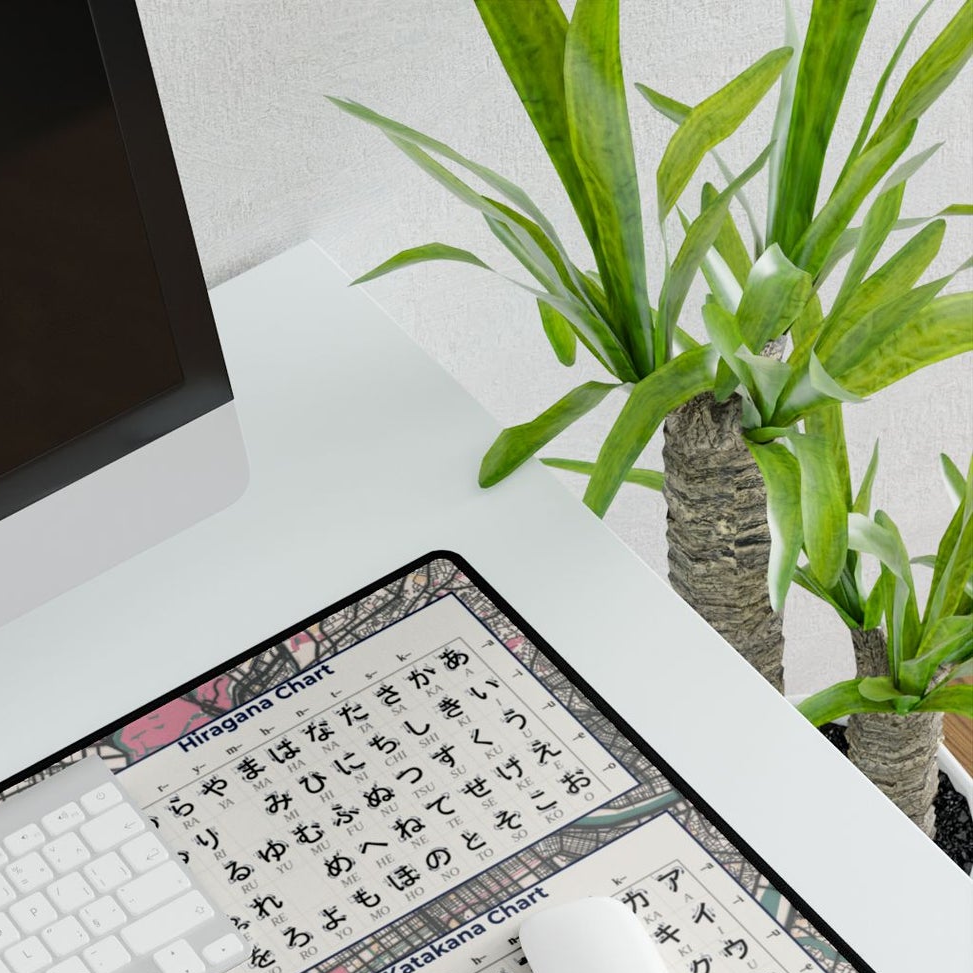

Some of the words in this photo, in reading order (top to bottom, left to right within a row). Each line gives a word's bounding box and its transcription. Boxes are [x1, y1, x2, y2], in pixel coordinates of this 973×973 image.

[438, 649, 469, 670] あ
[408, 668, 436, 689] か
[376, 685, 401, 707] さ
[425, 684, 444, 698] KA
[470, 681, 499, 700] い
[177, 698, 274, 753] Hiragana
[275, 664, 335, 700] Chart
[339, 704, 369, 726] た
[391, 704, 408, 716] SA
[439, 698, 463, 718] き
[357, 722, 374, 734] TA
[404, 721, 430, 736] し
[457, 714, 472, 727] KI
[504, 709, 526, 730] う
[305, 722, 335, 742] な
[418, 732, 440, 749] SHI
[473, 729, 493, 745] く
[268, 740, 301, 764] は
[321, 740, 341, 754] NA
[369, 735, 397, 754] ち
[484, 744, 503, 760] KU
[532, 741, 562, 764] え
[286, 759, 306, 773] HA
[334, 752, 366, 775] に
[384, 750, 408, 767] CHI
[432, 745, 455, 768] す
[237, 758, 266, 780] ま
[354, 771, 369, 784] NI
[396, 767, 423, 784] つ
[450, 764, 467, 779] SU
[496, 758, 523, 780] け
[202, 779, 228, 797] や
[299, 773, 327, 794] ひ
[411, 782, 436, 799] TSU
[464, 778, 492, 798] せ
[515, 776, 534, 791] KE
[561, 771, 591, 794] お
[264, 793, 293, 814] み
[319, 790, 335, 803] HI
[363, 787, 395, 808] ぬ
[426, 796, 455, 815] て
[481, 797, 498, 810] SE
[531, 791, 557, 811] こ
[170, 796, 194, 817] ら
[380, 802, 399, 818] NU
[544, 806, 564, 824] KO
[332, 806, 359, 827] ふ
[446, 815, 464, 829] TE
[496, 811, 522, 830] そ
[293, 823, 323, 844] む
[346, 821, 364, 837] FU
[394, 818, 426, 839] ね
[511, 825, 528, 843] SO
[196, 828, 219, 850] り
[410, 834, 429, 849] NE
[461, 833, 486, 851] と
[258, 840, 286, 863] ゆ
[375, 853, 395, 869] HE
[426, 849, 451, 870] の
[475, 848, 494, 861] TO
[224, 861, 251, 881] る
[324, 855, 353, 877] め
[440, 867, 460, 882] NO
[387, 865, 420, 891] ほ
[658, 869, 679, 892] ア
[354, 890, 381, 908] も
[404, 886, 425, 902] HO
[623, 892, 649, 914] カ
[29, 907, 37, 917] P
[253, 896, 283, 917] れ
[487, 886, 550, 925] Chart
[695, 903, 714, 923] イ
[323, 909, 346, 931] よ
[643, 911, 663, 925] KA
[283, 927, 310, 948] ろ
[656, 925, 680, 943] キ
[251, 948, 276, 968] を
[677, 944, 693, 957] KI
[724, 939, 748, 959] ウ
